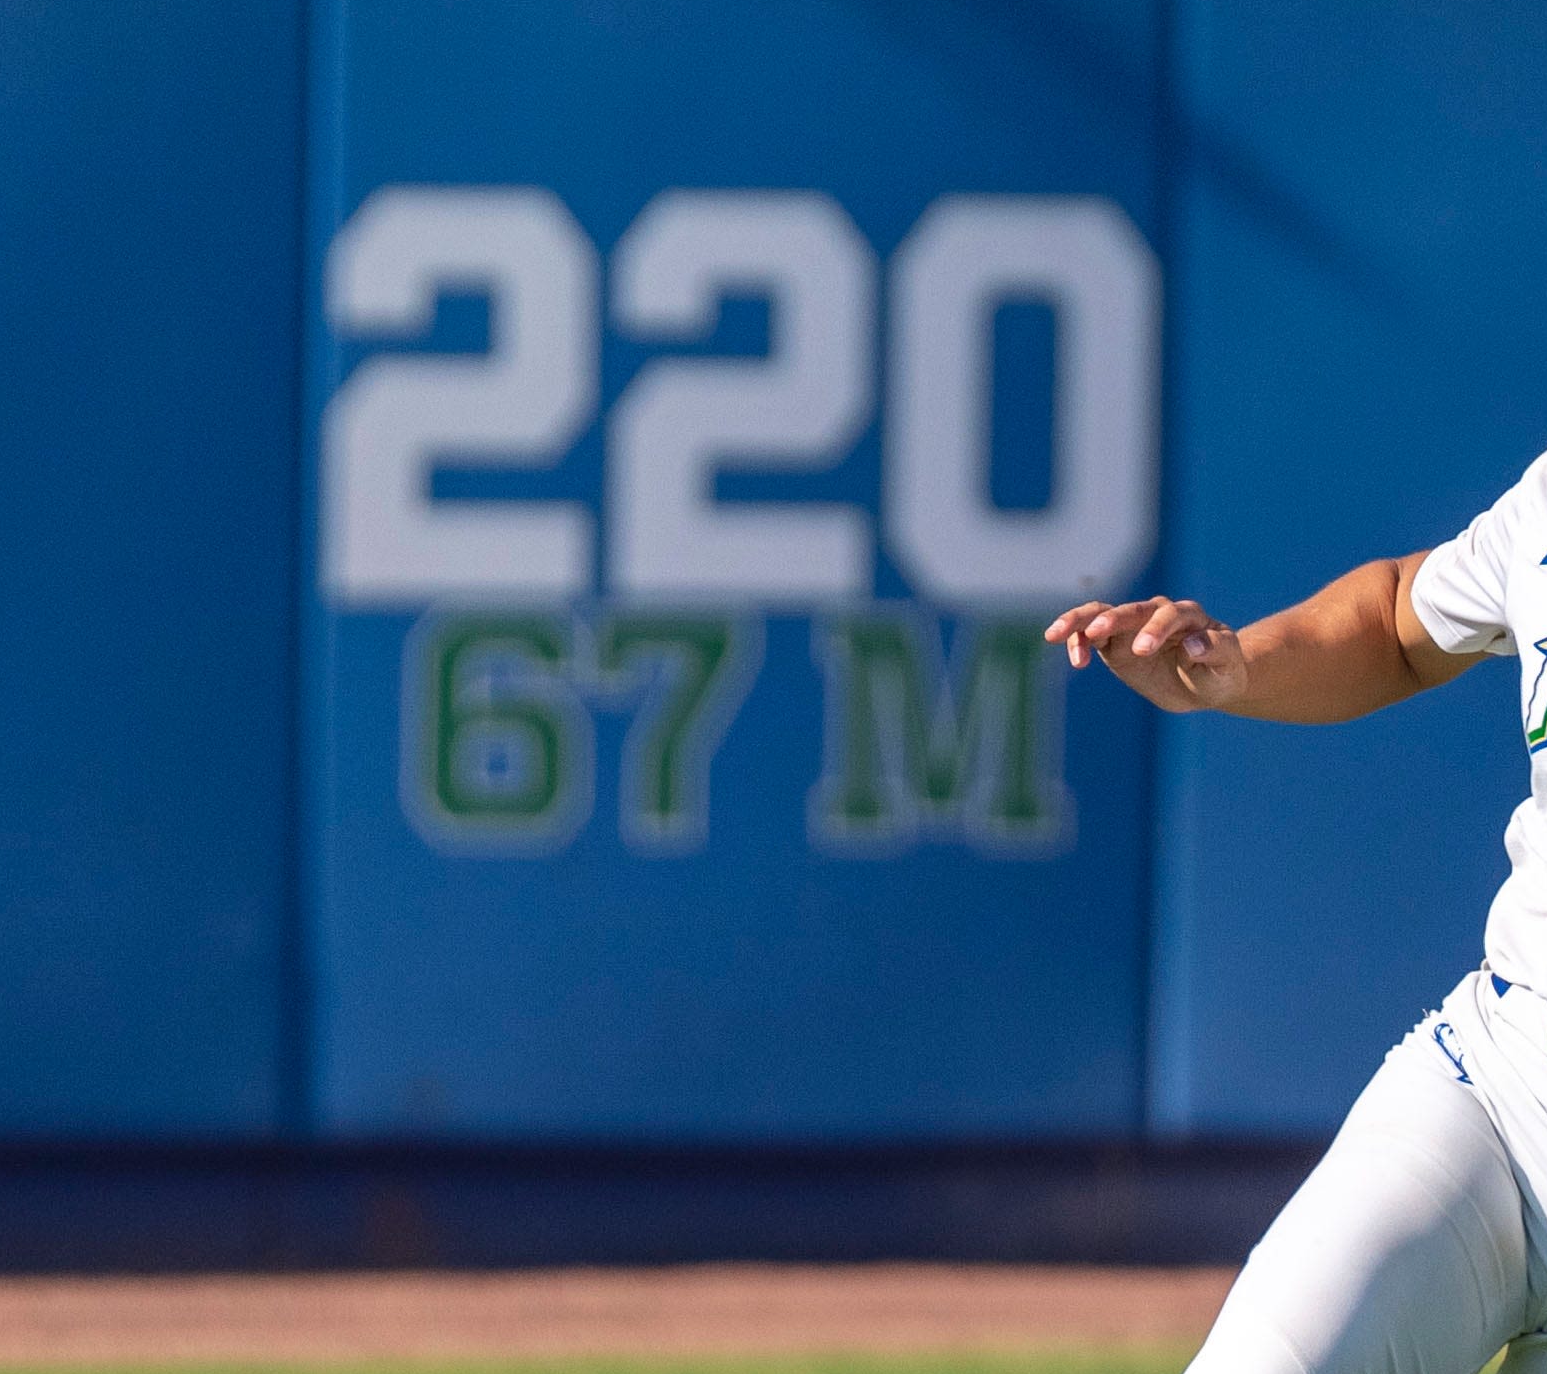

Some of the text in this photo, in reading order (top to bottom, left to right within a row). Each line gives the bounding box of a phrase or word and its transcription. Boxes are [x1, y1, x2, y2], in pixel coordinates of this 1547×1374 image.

[322, 185, 1162, 610] 220
[404, 605, 1074, 857] 67 M
